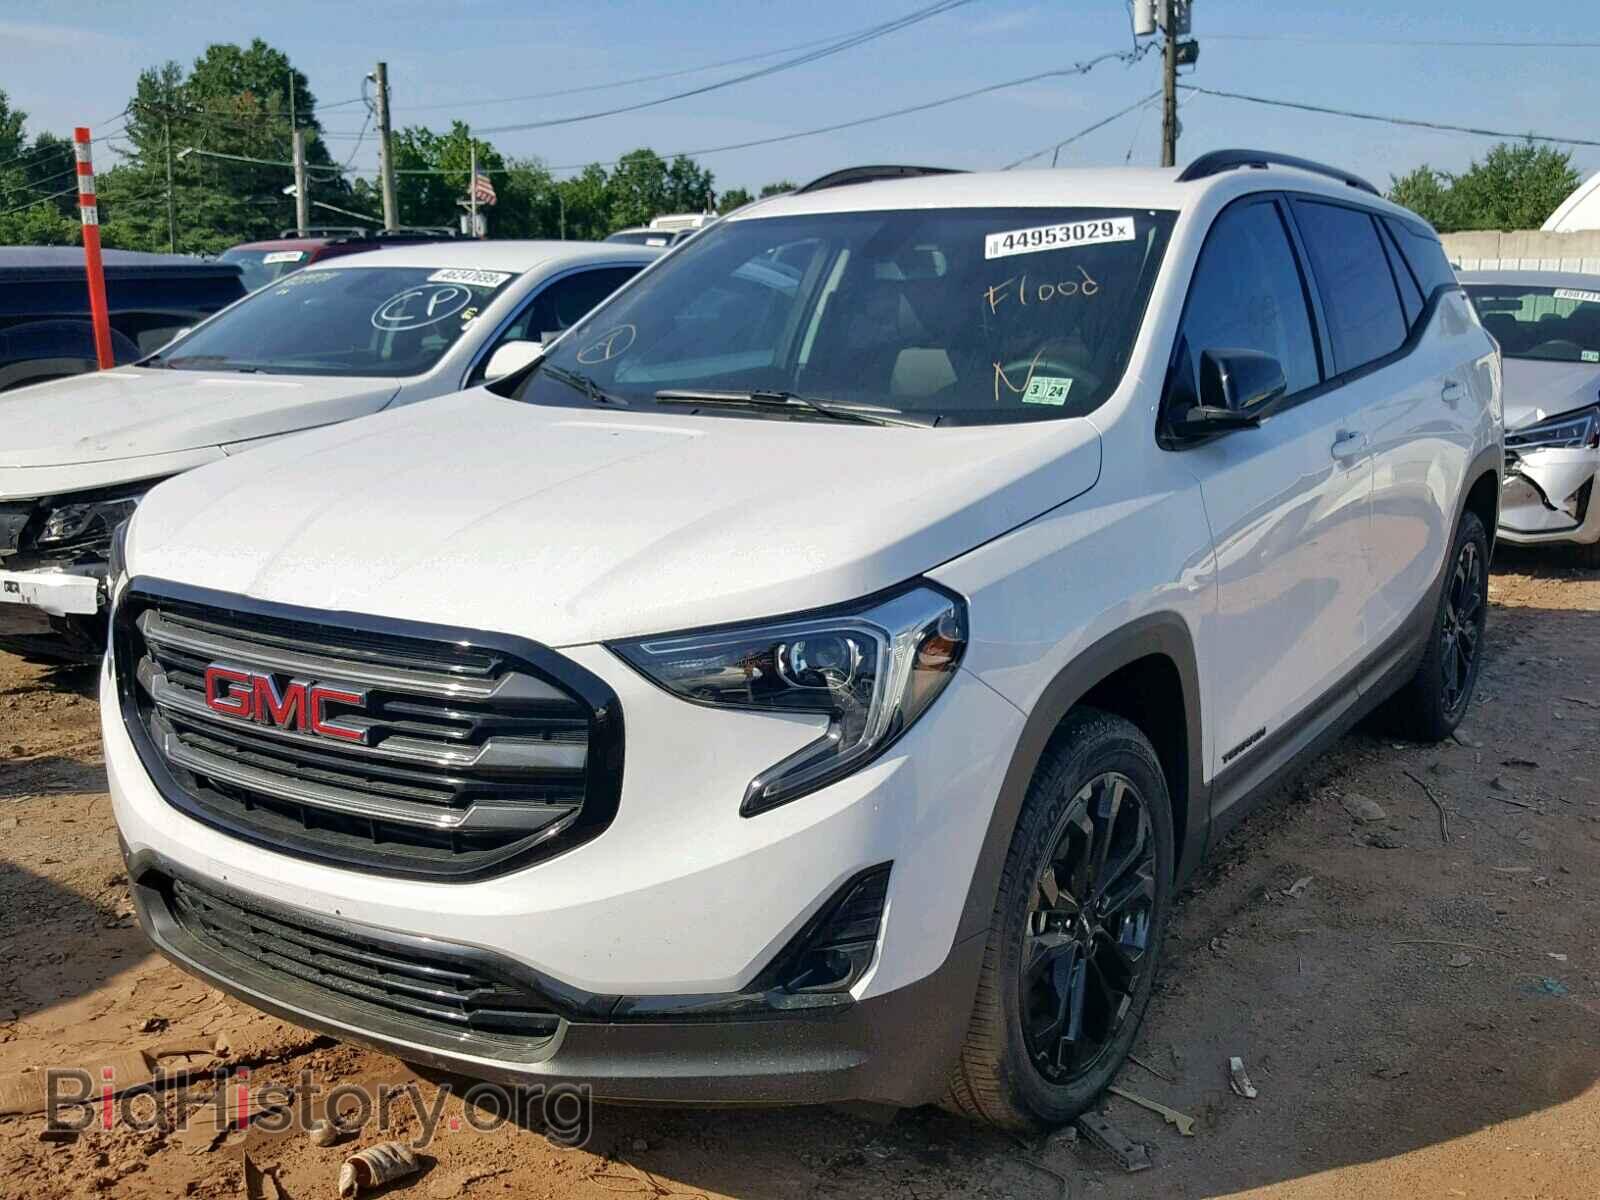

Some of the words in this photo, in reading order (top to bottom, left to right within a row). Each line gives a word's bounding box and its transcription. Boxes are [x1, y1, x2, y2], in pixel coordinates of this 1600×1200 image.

[1003, 221, 1114, 249] 44953029
[381, 288, 458, 320] CP
[984, 265, 1099, 314] Flood
[1030, 385, 1039, 395] 3
[1048, 387, 1064, 397] 24
[205, 660, 370, 744] GMC
